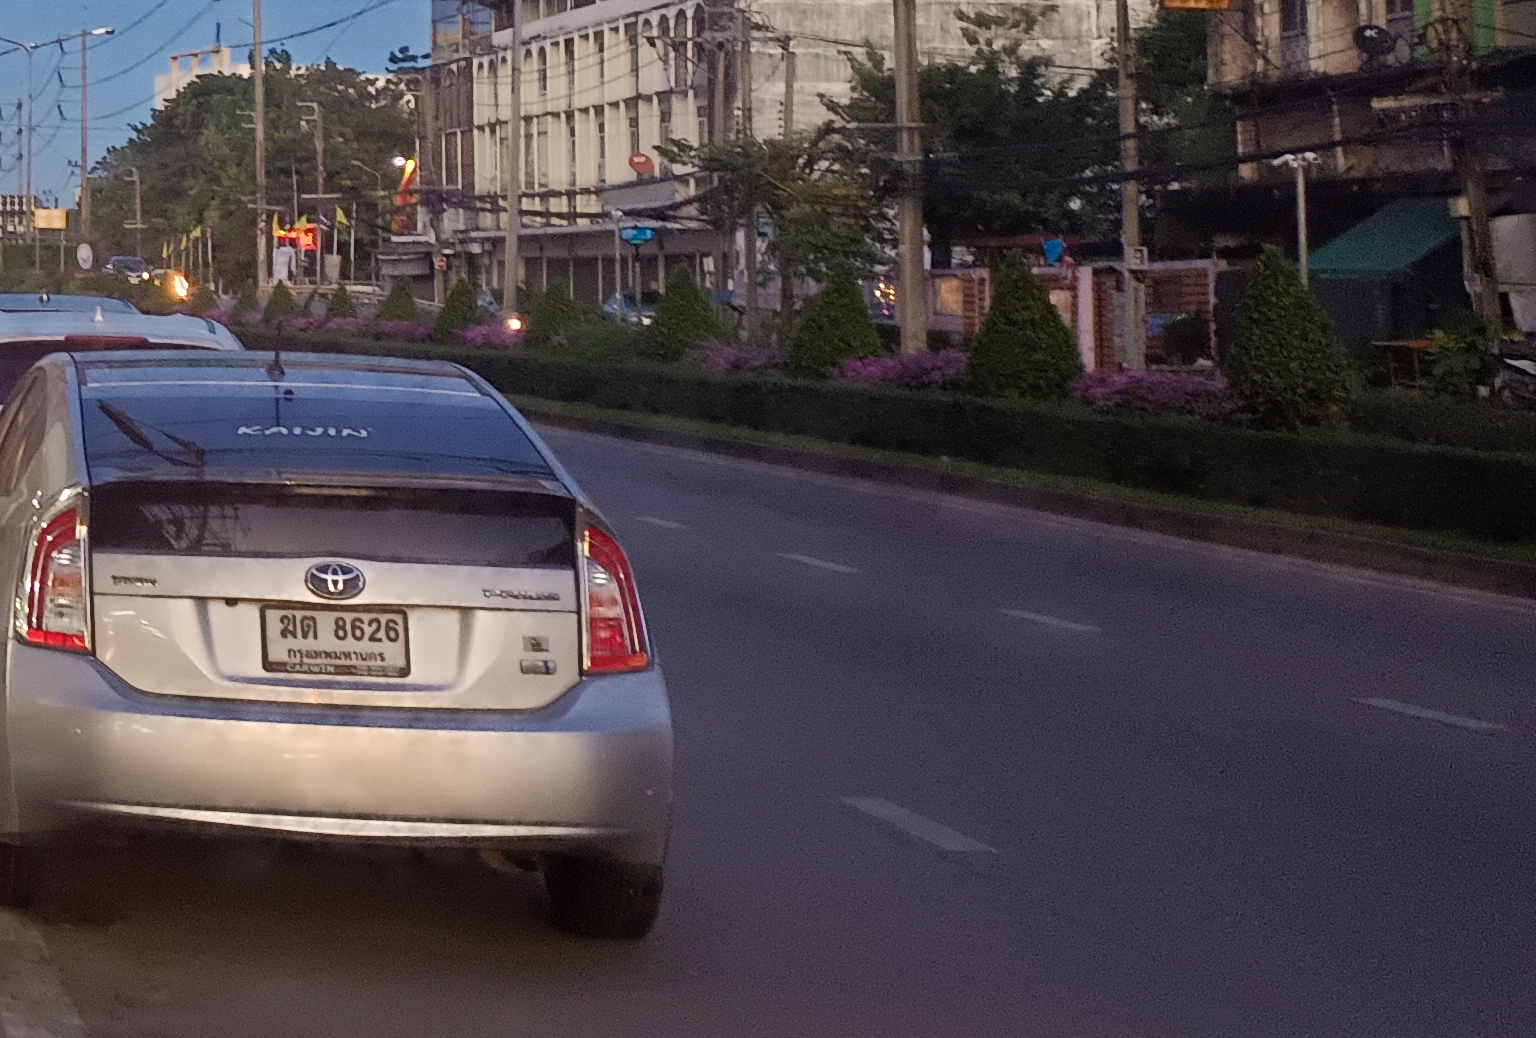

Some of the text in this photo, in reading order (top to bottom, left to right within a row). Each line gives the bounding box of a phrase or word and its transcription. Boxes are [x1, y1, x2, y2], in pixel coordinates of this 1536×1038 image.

[334, 616, 400, 643] 8626
[286, 648, 386, 664] กรุงเทพมหานคร
